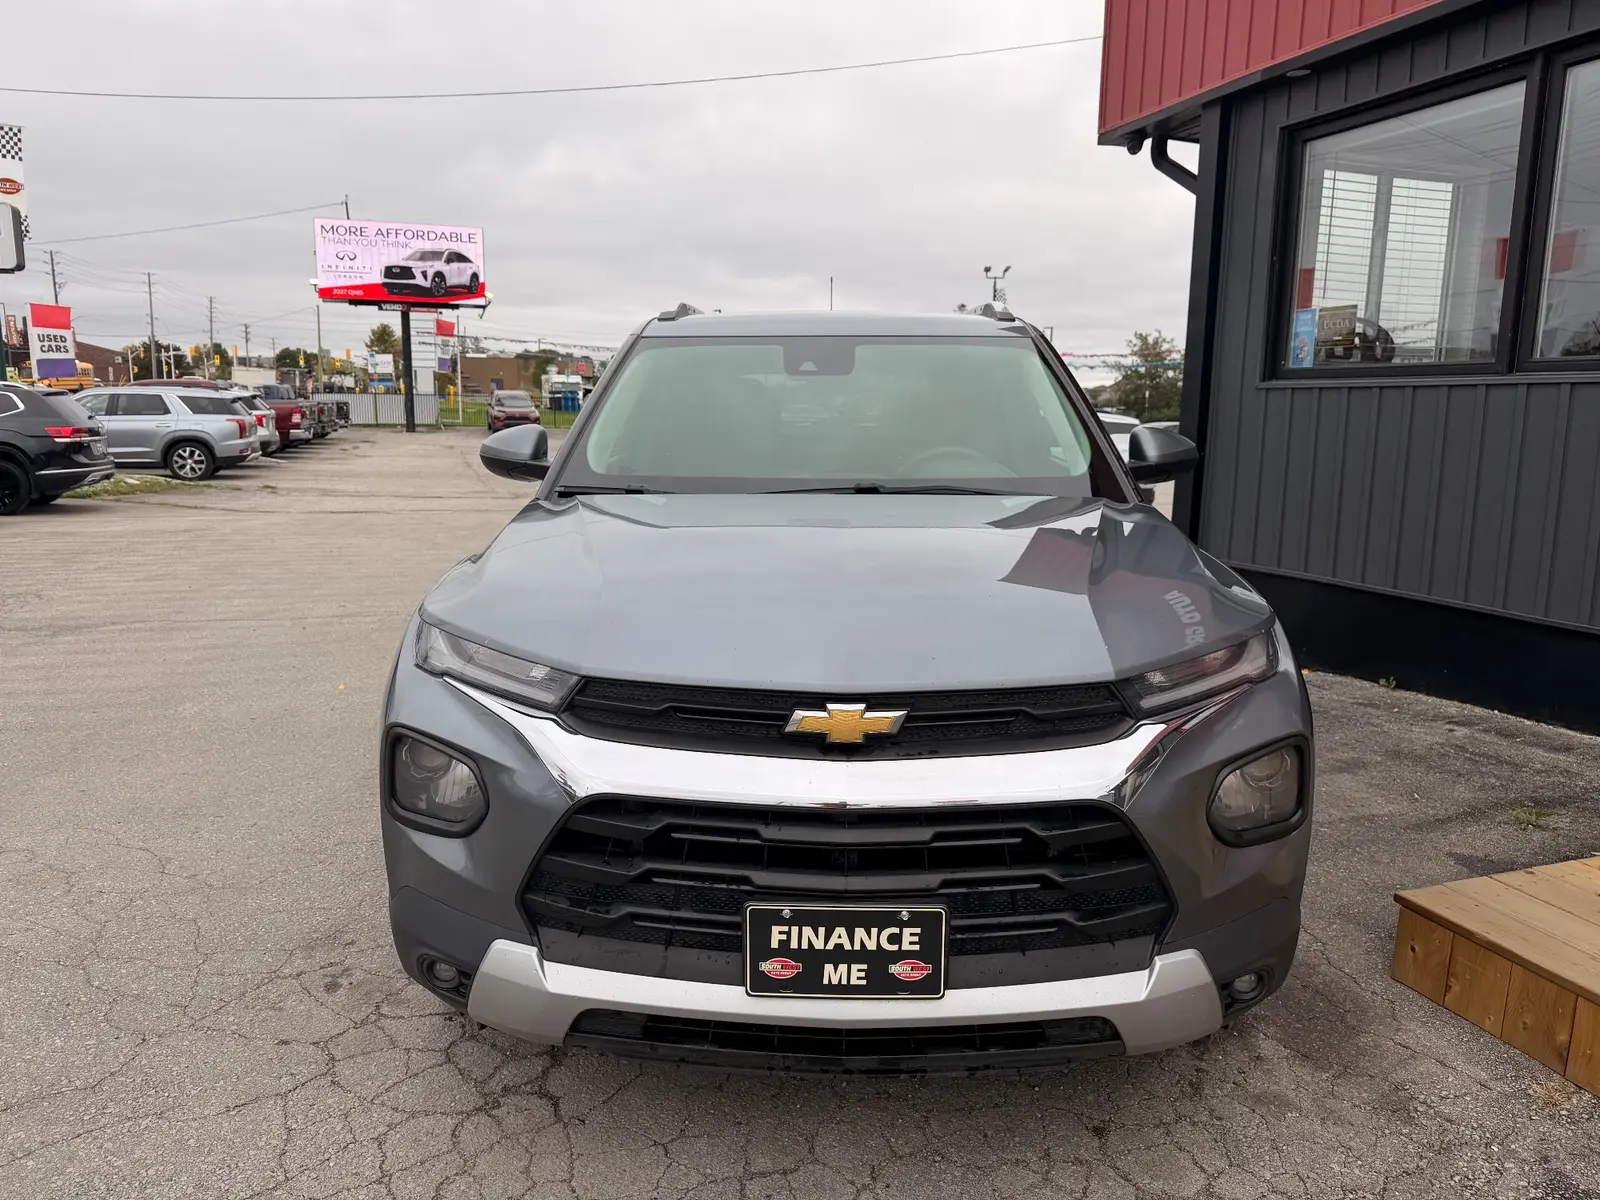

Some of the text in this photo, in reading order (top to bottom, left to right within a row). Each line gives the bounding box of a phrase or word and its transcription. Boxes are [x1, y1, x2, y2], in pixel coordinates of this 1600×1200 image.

[320, 224, 478, 244] MORE AFFORDABLE
[321, 236, 351, 246] THAN
[352, 238, 377, 247] YOU
[1323, 319, 1351, 329] UCDA
[37, 333, 67, 343] USED
[40, 344, 69, 354] CARS
[770, 925, 922, 951] FINANCE
[822, 963, 868, 985] ME
